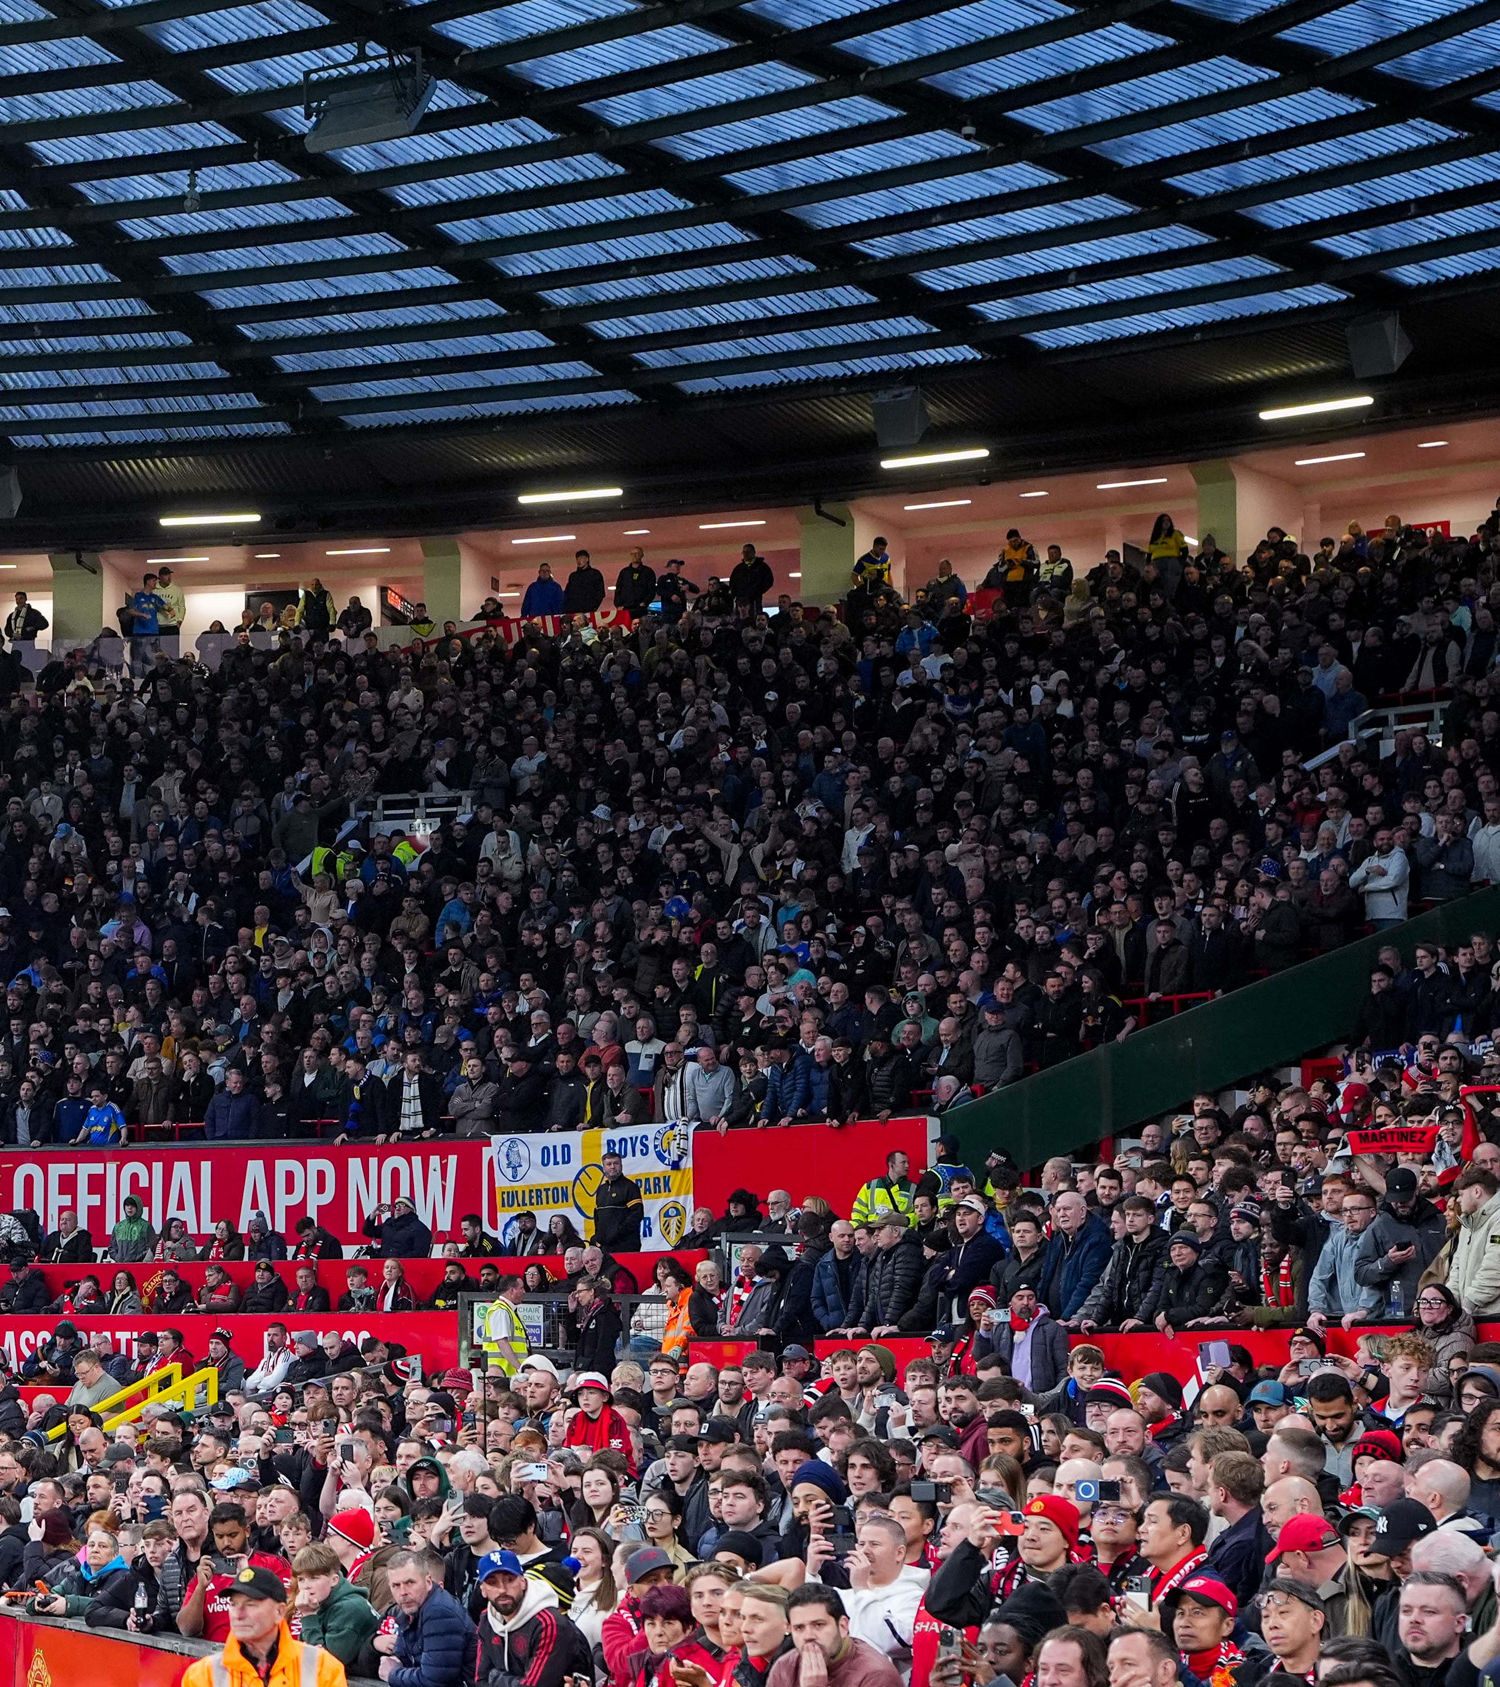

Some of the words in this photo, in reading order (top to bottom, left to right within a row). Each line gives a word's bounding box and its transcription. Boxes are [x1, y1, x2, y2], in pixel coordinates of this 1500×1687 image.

[540, 1143, 571, 1167] OLD
[606, 1134, 650, 1159] BOYS
[1357, 1131, 1427, 1144] MARTINEZ
[13, 1160, 213, 1236] OFFICIAL
[238, 1159, 336, 1235] APP
[348, 1154, 458, 1233] NOW
[501, 1185, 569, 1208] FULLERTON
